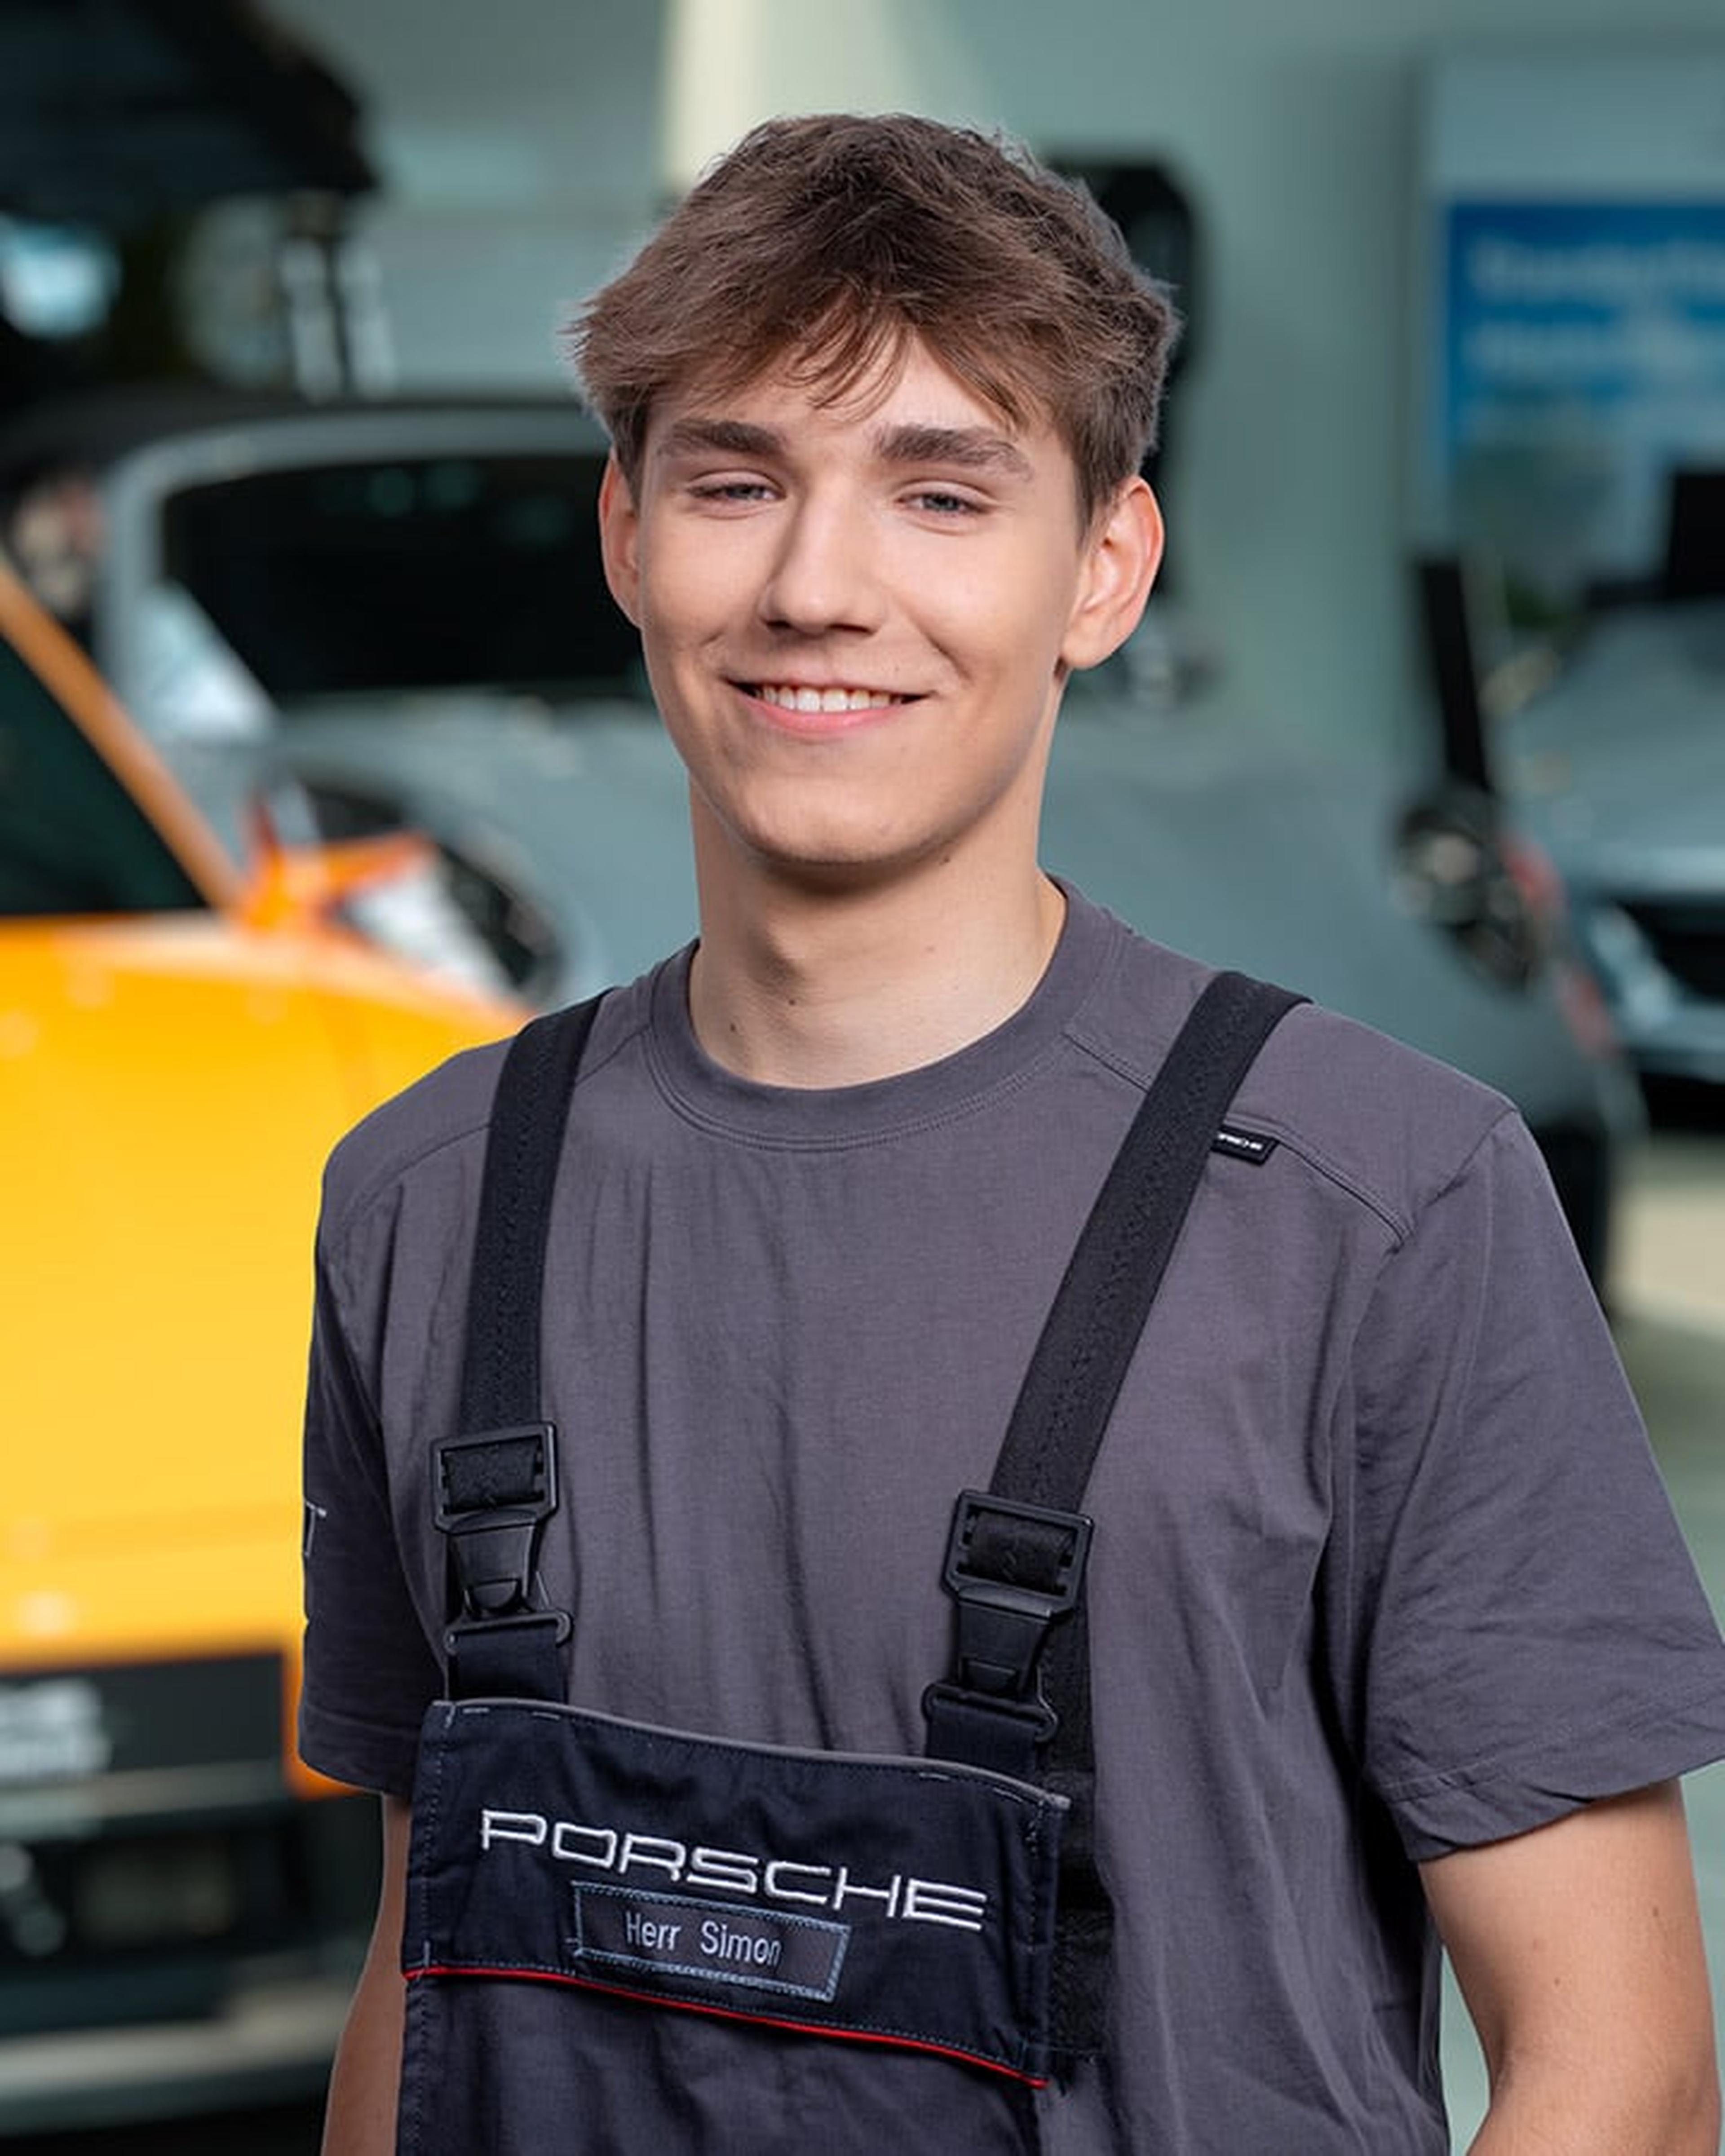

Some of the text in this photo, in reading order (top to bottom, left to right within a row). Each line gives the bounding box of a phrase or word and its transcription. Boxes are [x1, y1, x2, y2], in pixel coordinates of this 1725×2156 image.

[481, 1810, 987, 1931] PORSCHE
[626, 1911, 782, 1966] Herr Simon
